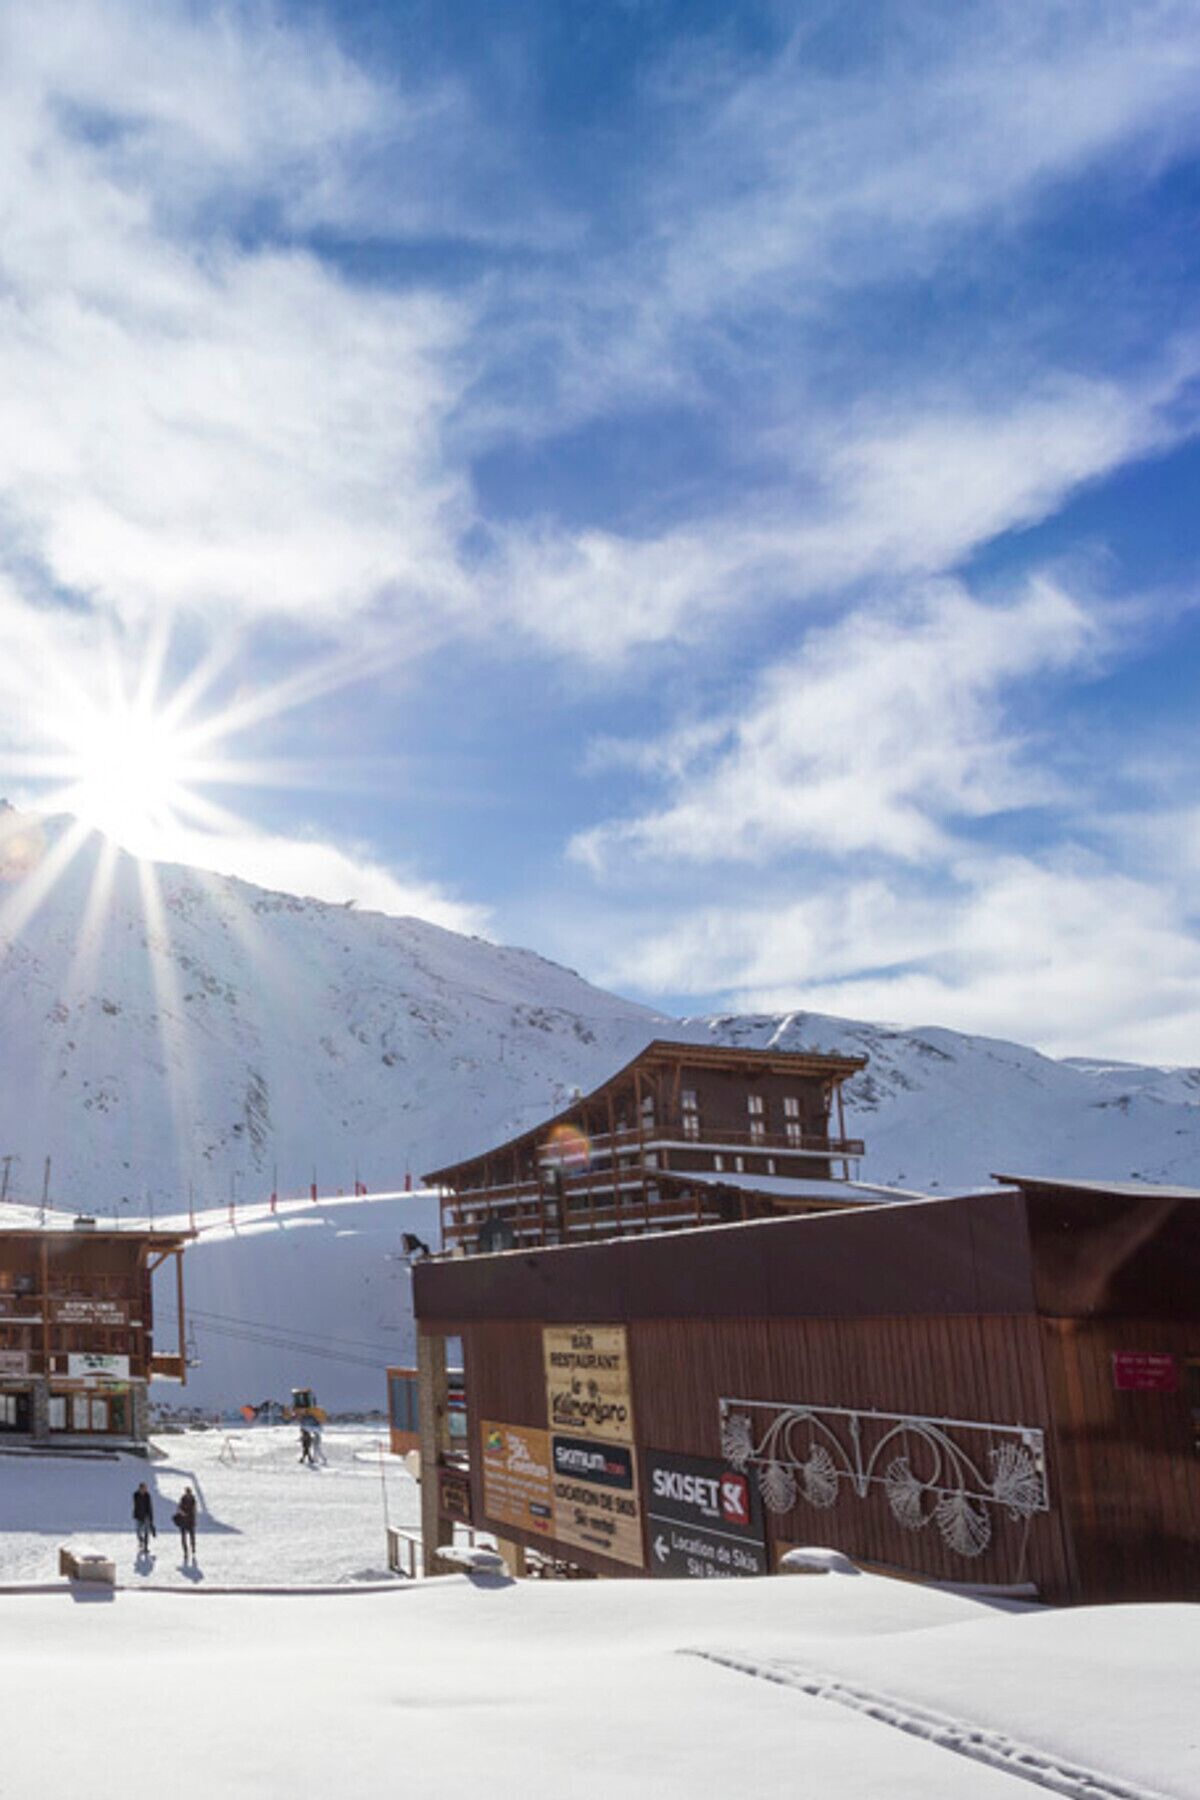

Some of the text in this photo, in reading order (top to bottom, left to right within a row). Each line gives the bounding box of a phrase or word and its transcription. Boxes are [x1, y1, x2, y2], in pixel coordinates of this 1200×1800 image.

[571, 1334, 593, 1350] BAR
[550, 1352, 620, 1371] RESTAURANT
[555, 1483, 637, 1518] LOCATION DE SKIS
[653, 1468, 720, 1509] SKISET
[671, 1531, 759, 1572] Location de Skis
